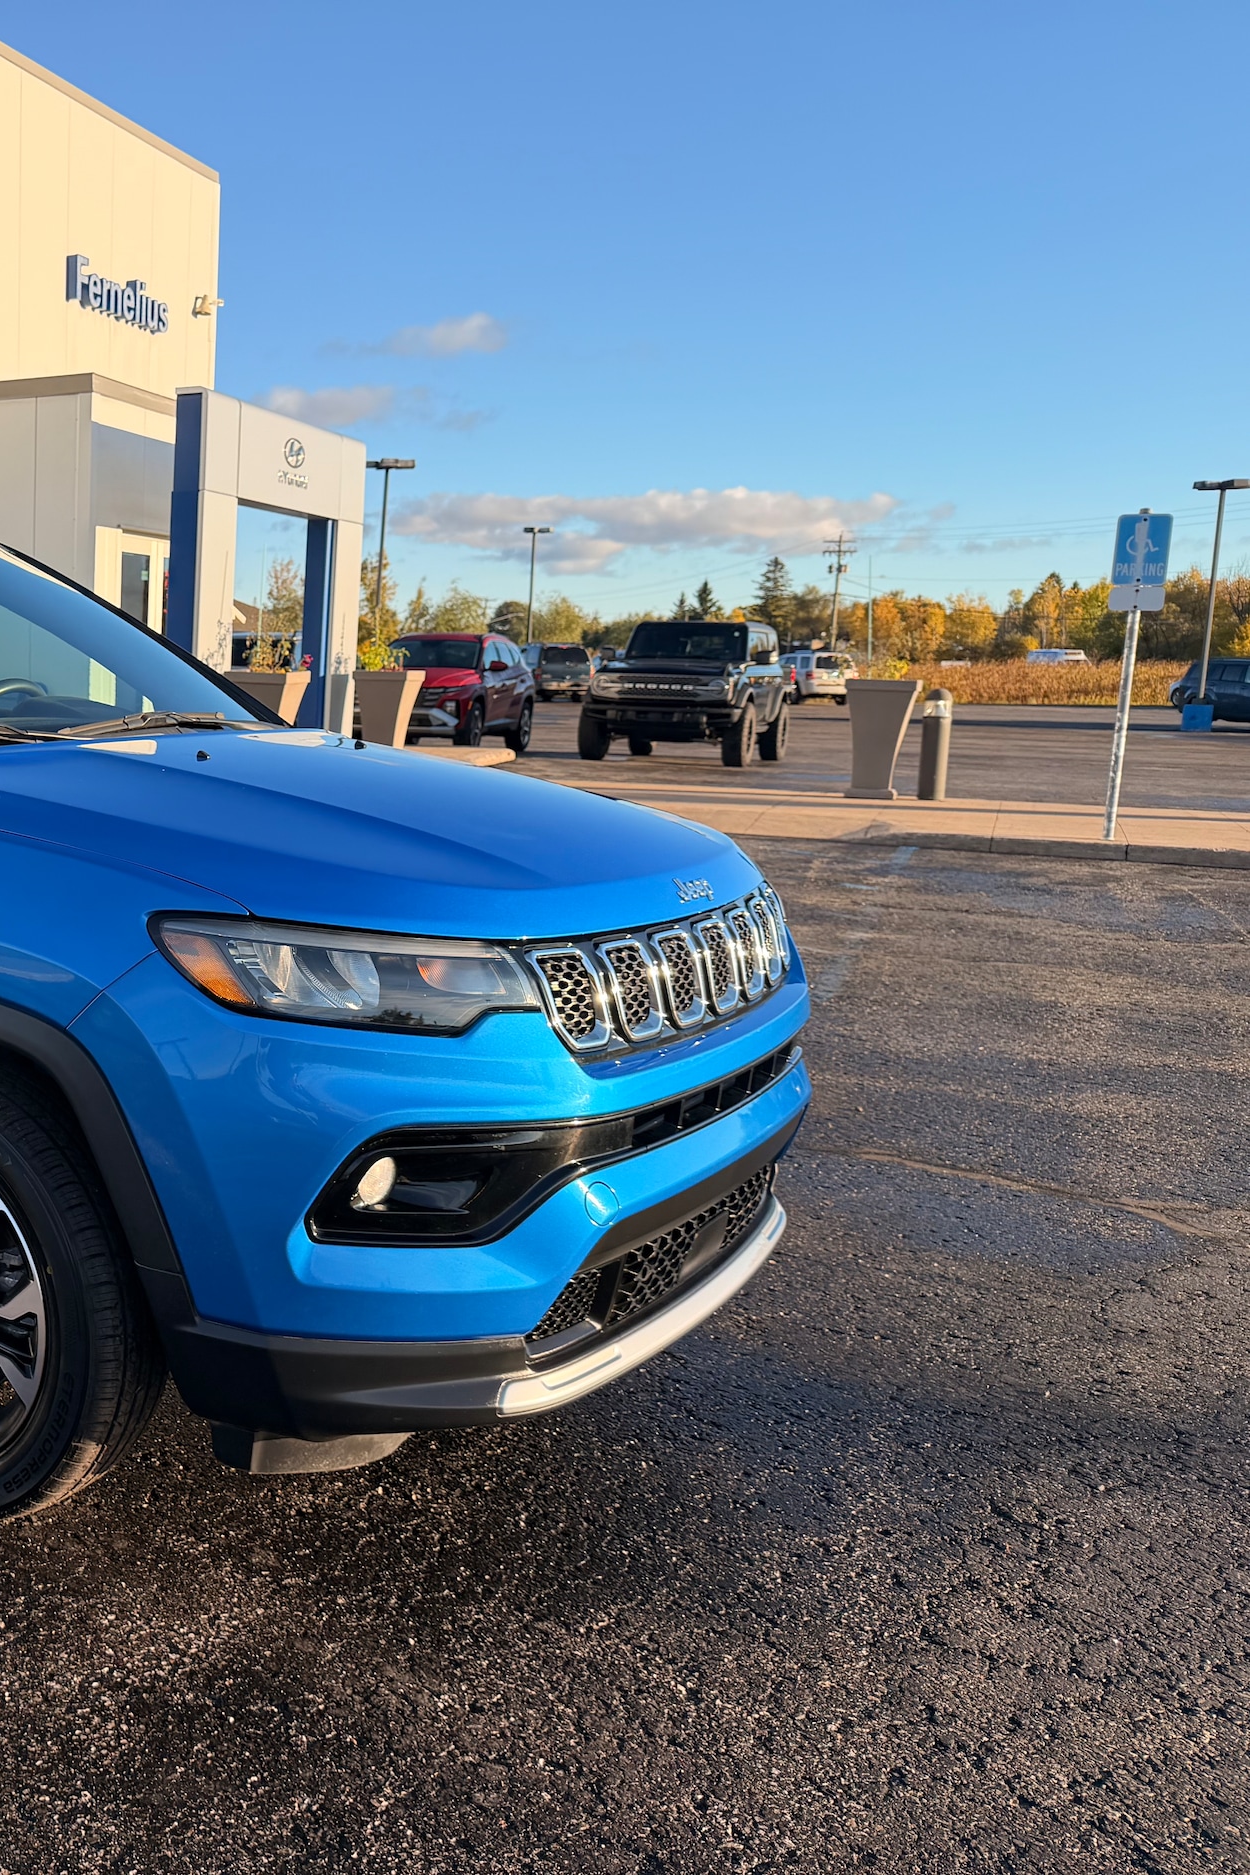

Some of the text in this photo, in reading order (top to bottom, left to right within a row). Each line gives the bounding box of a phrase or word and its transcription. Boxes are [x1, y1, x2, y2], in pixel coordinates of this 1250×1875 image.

[66, 253, 168, 334] Fernelius
[623, 682, 694, 691] BRONCO
[672, 877, 714, 903] Jeep
